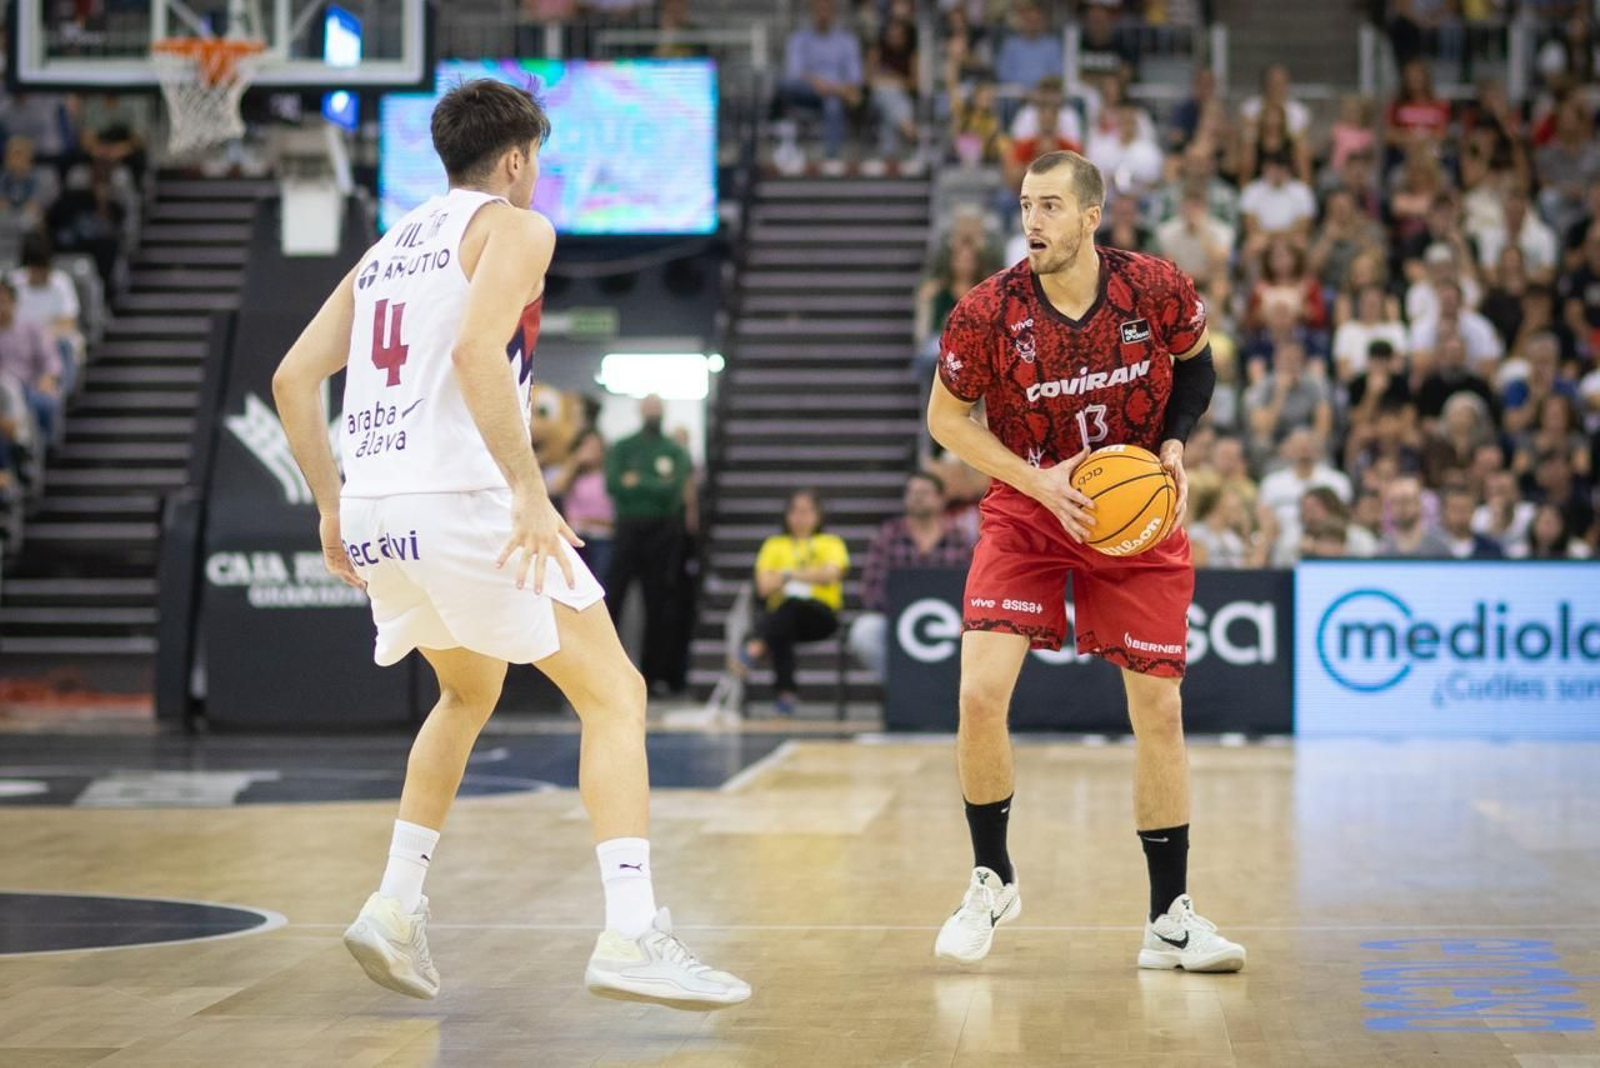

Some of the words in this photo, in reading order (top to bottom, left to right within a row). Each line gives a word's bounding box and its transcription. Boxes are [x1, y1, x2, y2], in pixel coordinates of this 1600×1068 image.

[382, 248, 450, 282] AMUTIO
[1010, 318, 1034, 332] vive
[371, 298, 409, 387] 4
[347, 401, 397, 435] araba
[1075, 404, 1108, 448] 13
[355, 429, 406, 459] álava
[971, 598, 996, 609] vive
[1131, 639, 1182, 654] BERNER
